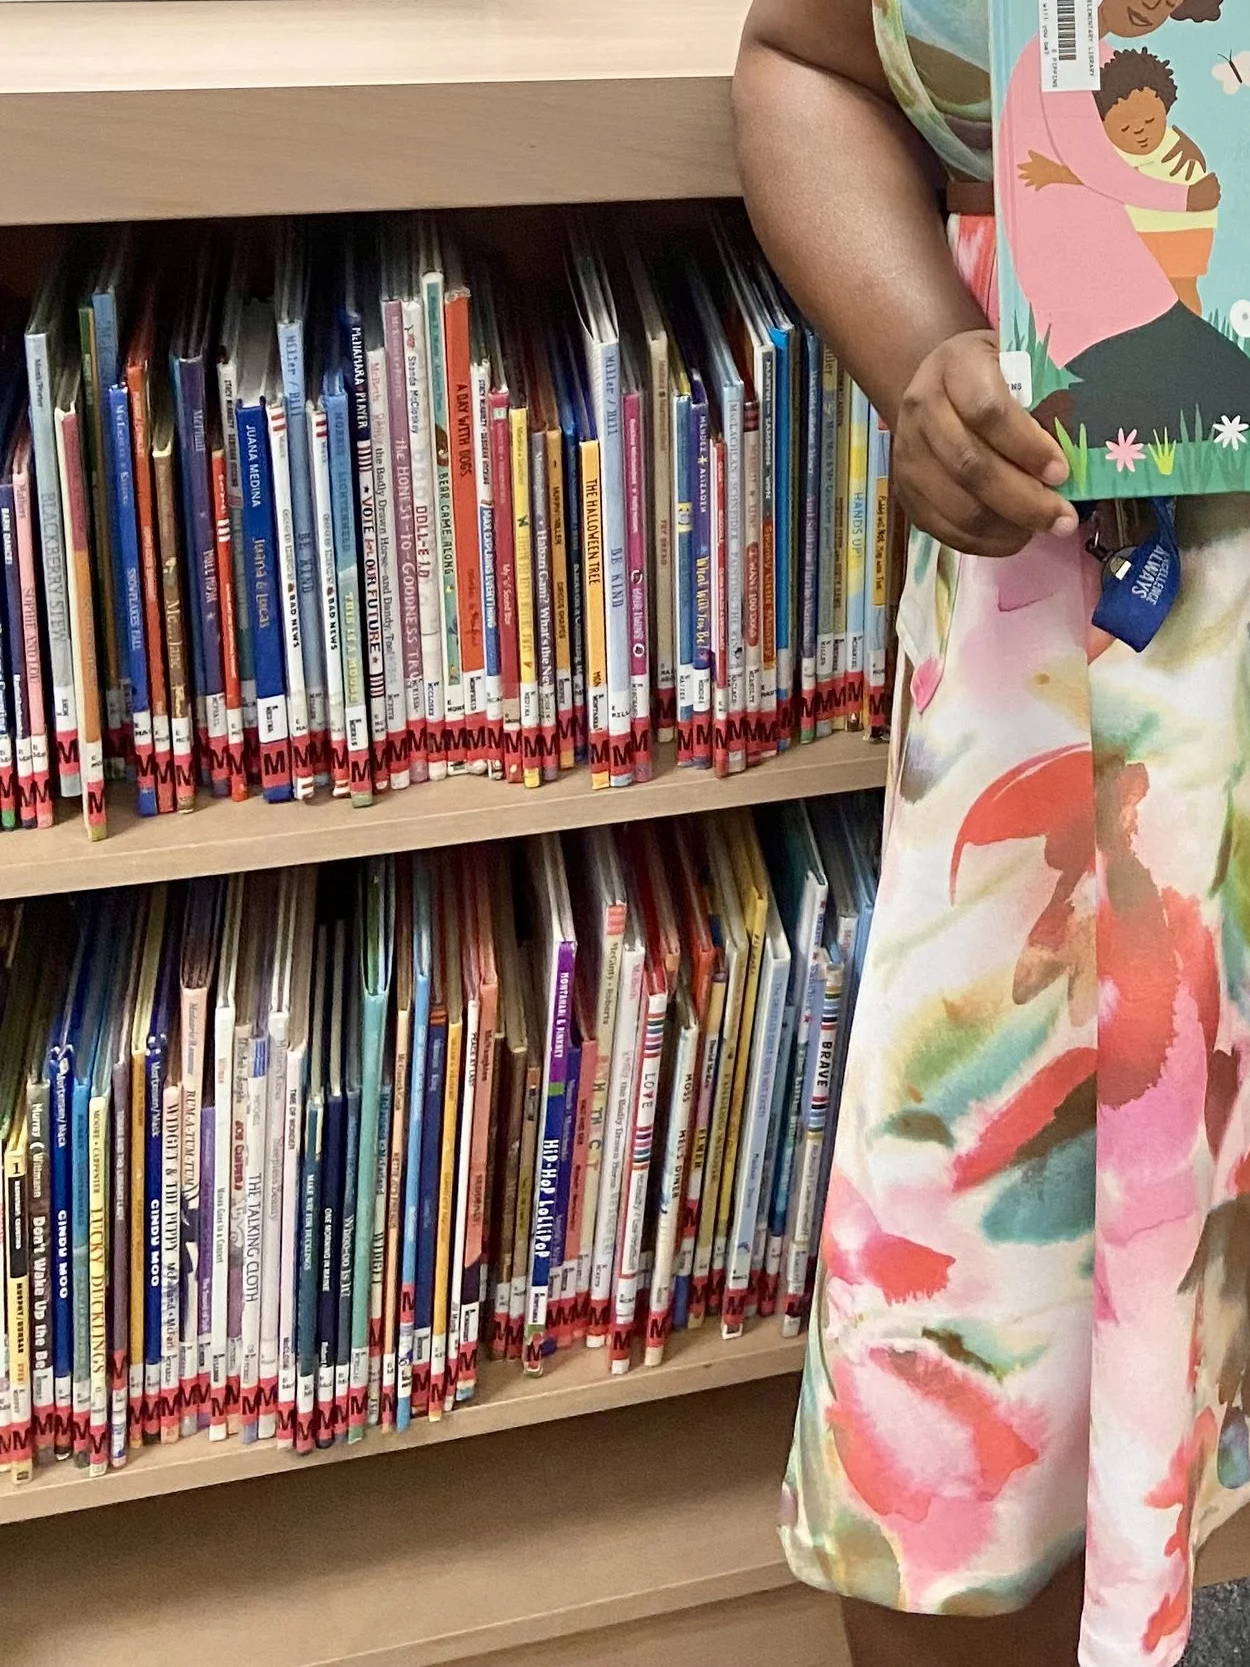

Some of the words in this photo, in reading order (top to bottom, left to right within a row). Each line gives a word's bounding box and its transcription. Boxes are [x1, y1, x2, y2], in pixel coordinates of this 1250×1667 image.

[1086, 0, 1094, 42] ELEMENTARY
[285, 335, 297, 375] Miller
[408, 356, 417, 386] Shanda
[605, 355, 616, 394] Miller
[356, 392, 368, 429] PLAYER
[410, 389, 419, 434] McCloskey
[457, 394, 468, 413] DAY
[245, 425, 258, 460] JUANA
[458, 416, 470, 446] WITH
[375, 448, 384, 464] the
[395, 438, 407, 461] the
[460, 450, 472, 477] DOGS
[249, 464, 261, 507] MEDINA
[375, 468, 386, 497] Badly
[438, 473, 449, 499] BEAR
[586, 478, 597, 496] THE
[362, 496, 374, 534] VOTE
[378, 500, 388, 535] Drawn
[441, 505, 451, 535] CAME
[482, 509, 493, 530] MAX
[729, 480, 739, 541] SCHNEIDER
[853, 492, 862, 535] HANDS
[41, 493, 63, 597] BLACKBERRY
[586, 500, 599, 560] HALLOWEEN
[443, 541, 453, 574] ALONG
[483, 532, 493, 574] EXPLAINS
[536, 530, 549, 569] Habari
[611, 547, 623, 564] BE
[764, 526, 773, 569] Spunky
[366, 559, 376, 586] OUR
[537, 570, 549, 604] Gani?
[589, 563, 600, 585] TREE
[696, 557, 710, 587] What
[730, 552, 738, 603] PAINTING
[1131, 544, 1165, 599] ALWAYS
[127, 567, 139, 627] SNOWFLAKES
[289, 595, 298, 616] BAD
[328, 598, 336, 618] BAD
[485, 576, 495, 629] EVERYTHING
[503, 589, 511, 611] Sound
[611, 574, 624, 608] KIND
[749, 593, 758, 611] 100
[50, 601, 66, 642] STEW
[256, 594, 270, 629] Lucas
[368, 590, 381, 653] FUTURE
[540, 607, 551, 646] What's
[730, 606, 739, 626] THE
[291, 619, 299, 648] NEWS
[348, 658, 359, 703] MOOSE
[605, 942, 618, 980] McGinty
[603, 988, 614, 1025] Roberts
[816, 1041, 833, 1088] BRAVE
[289, 1089, 297, 1104] TIME
[682, 1074, 694, 1103] MOSS
[32, 1102, 44, 1137] Murray
[289, 1106, 296, 1117] OF
[615, 1099, 625, 1126] Badly
[165, 1103, 178, 1166] WIDGET
[184, 1090, 196, 1186] RUM-A-TUM-TUM
[288, 1119, 296, 1150] WONDER
[613, 1128, 623, 1159] Drawn
[675, 1130, 687, 1160] MEL'S
[693, 1128, 706, 1170] ELMER
[92, 1147, 101, 1193] CARPENTER
[165, 1168, 177, 1177] &
[248, 1173, 262, 1198] THE
[305, 1174, 315, 1195] MAKE
[672, 1165, 683, 1198] DINER
[165, 1181, 177, 1206] THE
[305, 1197, 315, 1212] WAY
[165, 1211, 178, 1252] PUPPY
[247, 1204, 261, 1257] TALKING
[305, 1213, 314, 1228] FOR
[324, 1208, 333, 1223] ONE
[33, 1216, 46, 1254] Don't
[90, 1207, 104, 1264] LUCKY
[216, 1239, 225, 1263] Concert
[303, 1229, 313, 1270] DUCKLINGS
[323, 1224, 332, 1258] MORNING
[341, 1215, 355, 1266] Whoo-oo
[33, 1257, 46, 1296] Wake
[58, 1262, 68, 1299] MOO
[151, 1251, 160, 1287] MOO
[246, 1261, 259, 1302] CLOTH
[322, 1268, 331, 1291] MAINE
[33, 1300, 46, 1319] Up
[92, 1276, 105, 1374] DUCKLINGS
[34, 1324, 47, 1346] the
